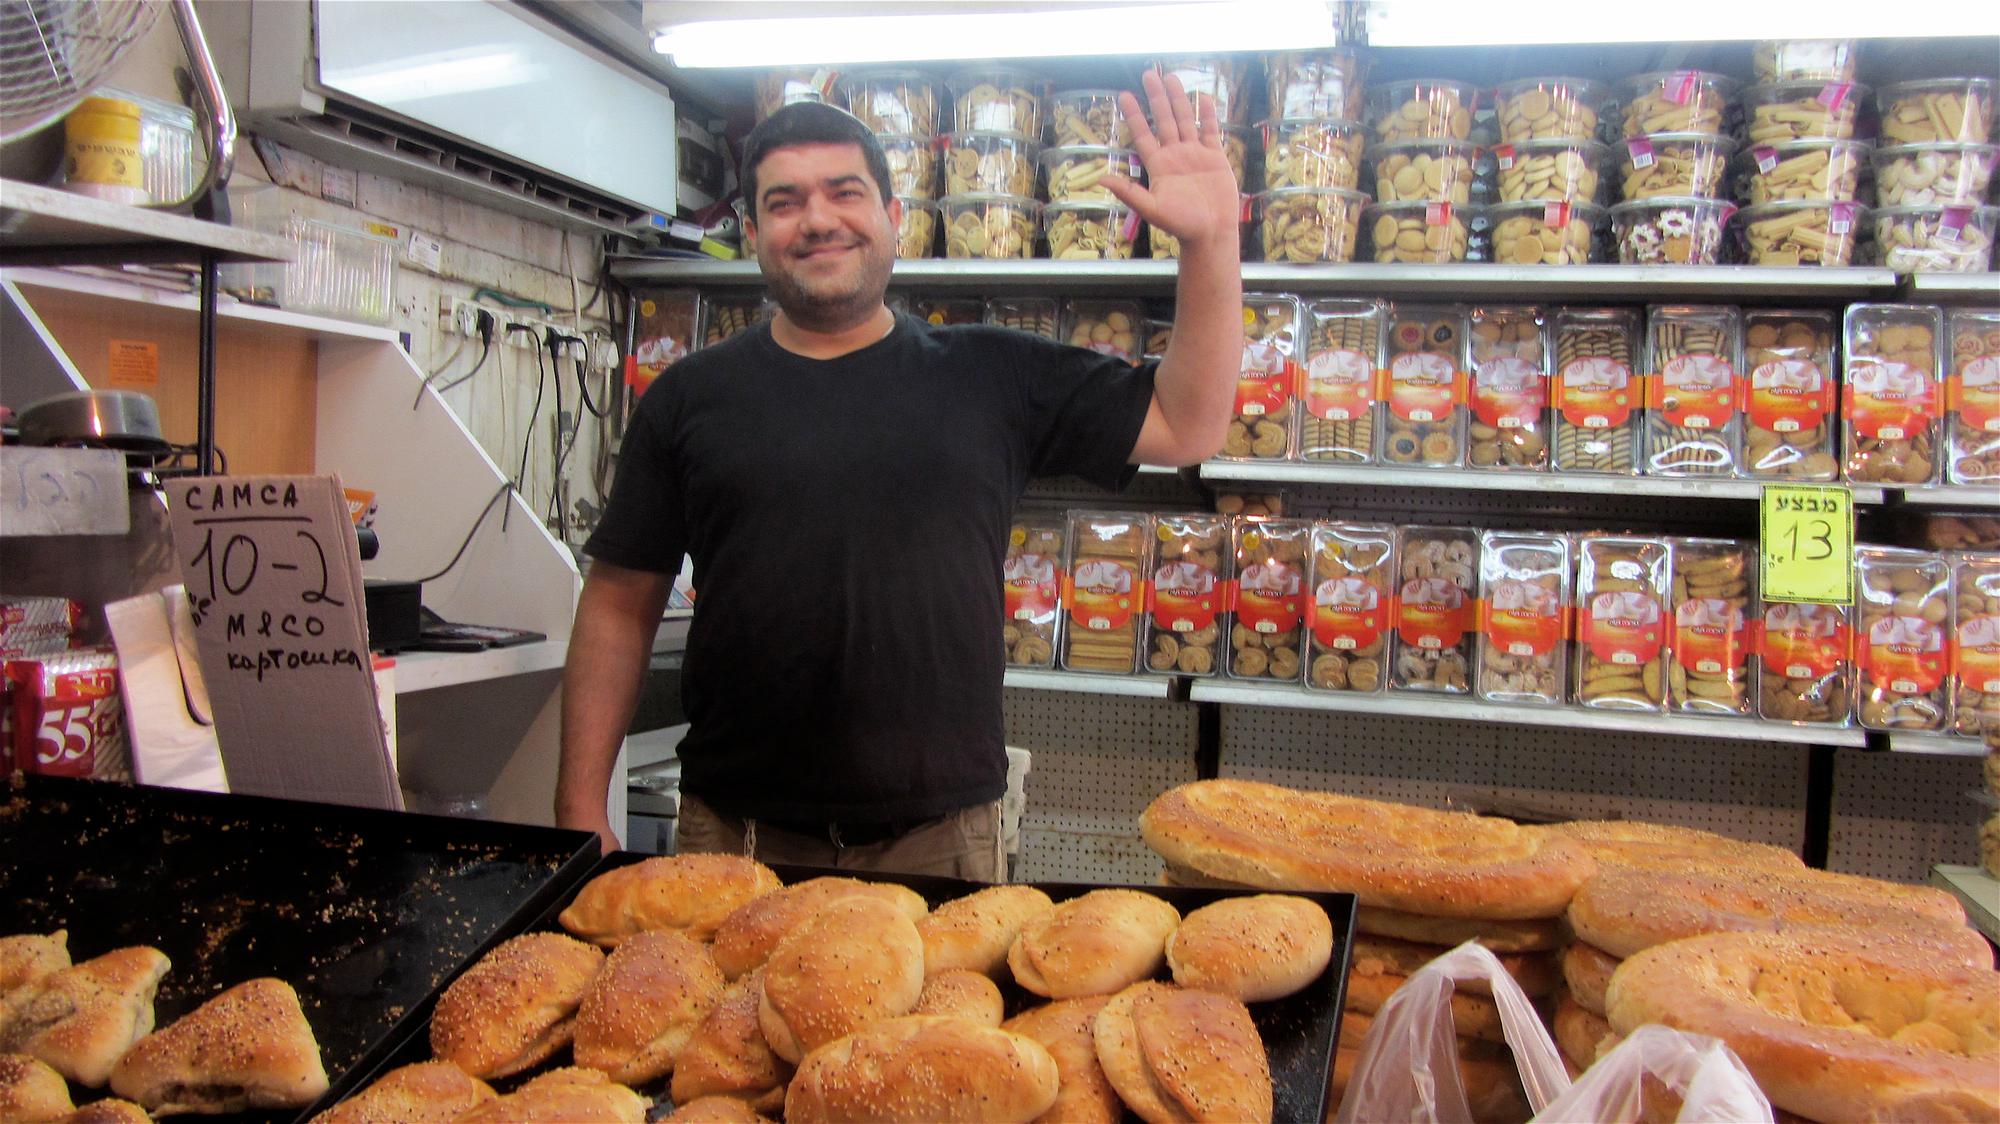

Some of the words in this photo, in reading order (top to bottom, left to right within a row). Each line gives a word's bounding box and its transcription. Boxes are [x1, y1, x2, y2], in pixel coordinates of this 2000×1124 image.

[186, 483, 299, 512] САМСА
[1775, 495, 1838, 513] מבצע
[1783, 519, 1833, 561] 13
[228, 649, 362, 682] картошка
[36, 705, 92, 764] 55
